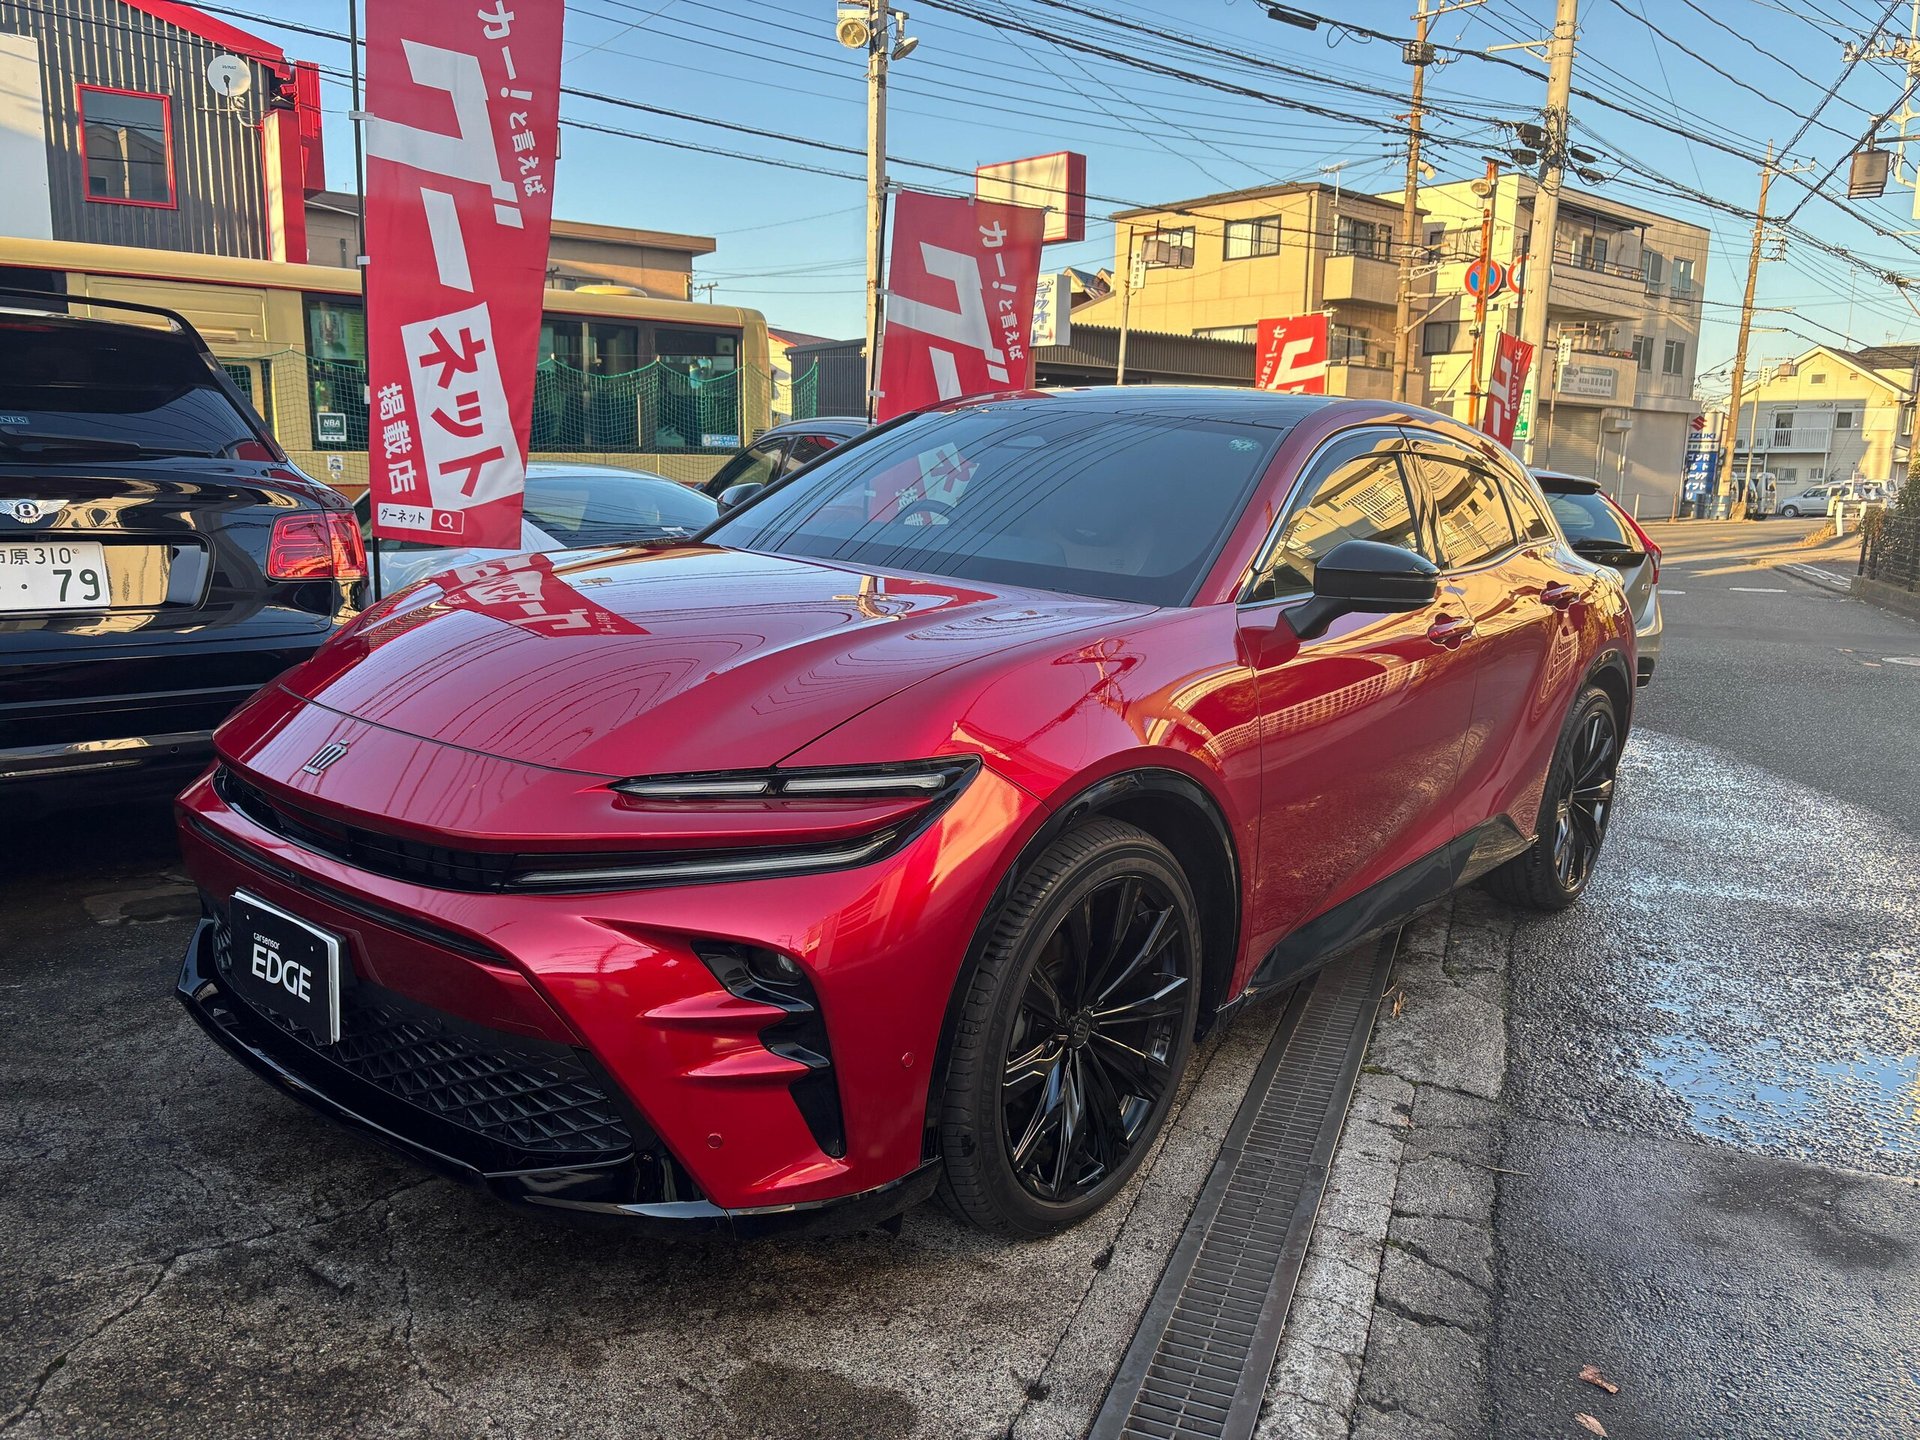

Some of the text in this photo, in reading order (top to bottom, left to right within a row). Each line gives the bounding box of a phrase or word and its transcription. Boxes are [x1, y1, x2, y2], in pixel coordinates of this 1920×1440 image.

[323, 419, 340, 427] NBA
[377, 382, 417, 494] 掲載店
[380, 508, 426, 525] グーネット
[253, 931, 281, 950] carsensor
[251, 942, 312, 1004] EDGE
